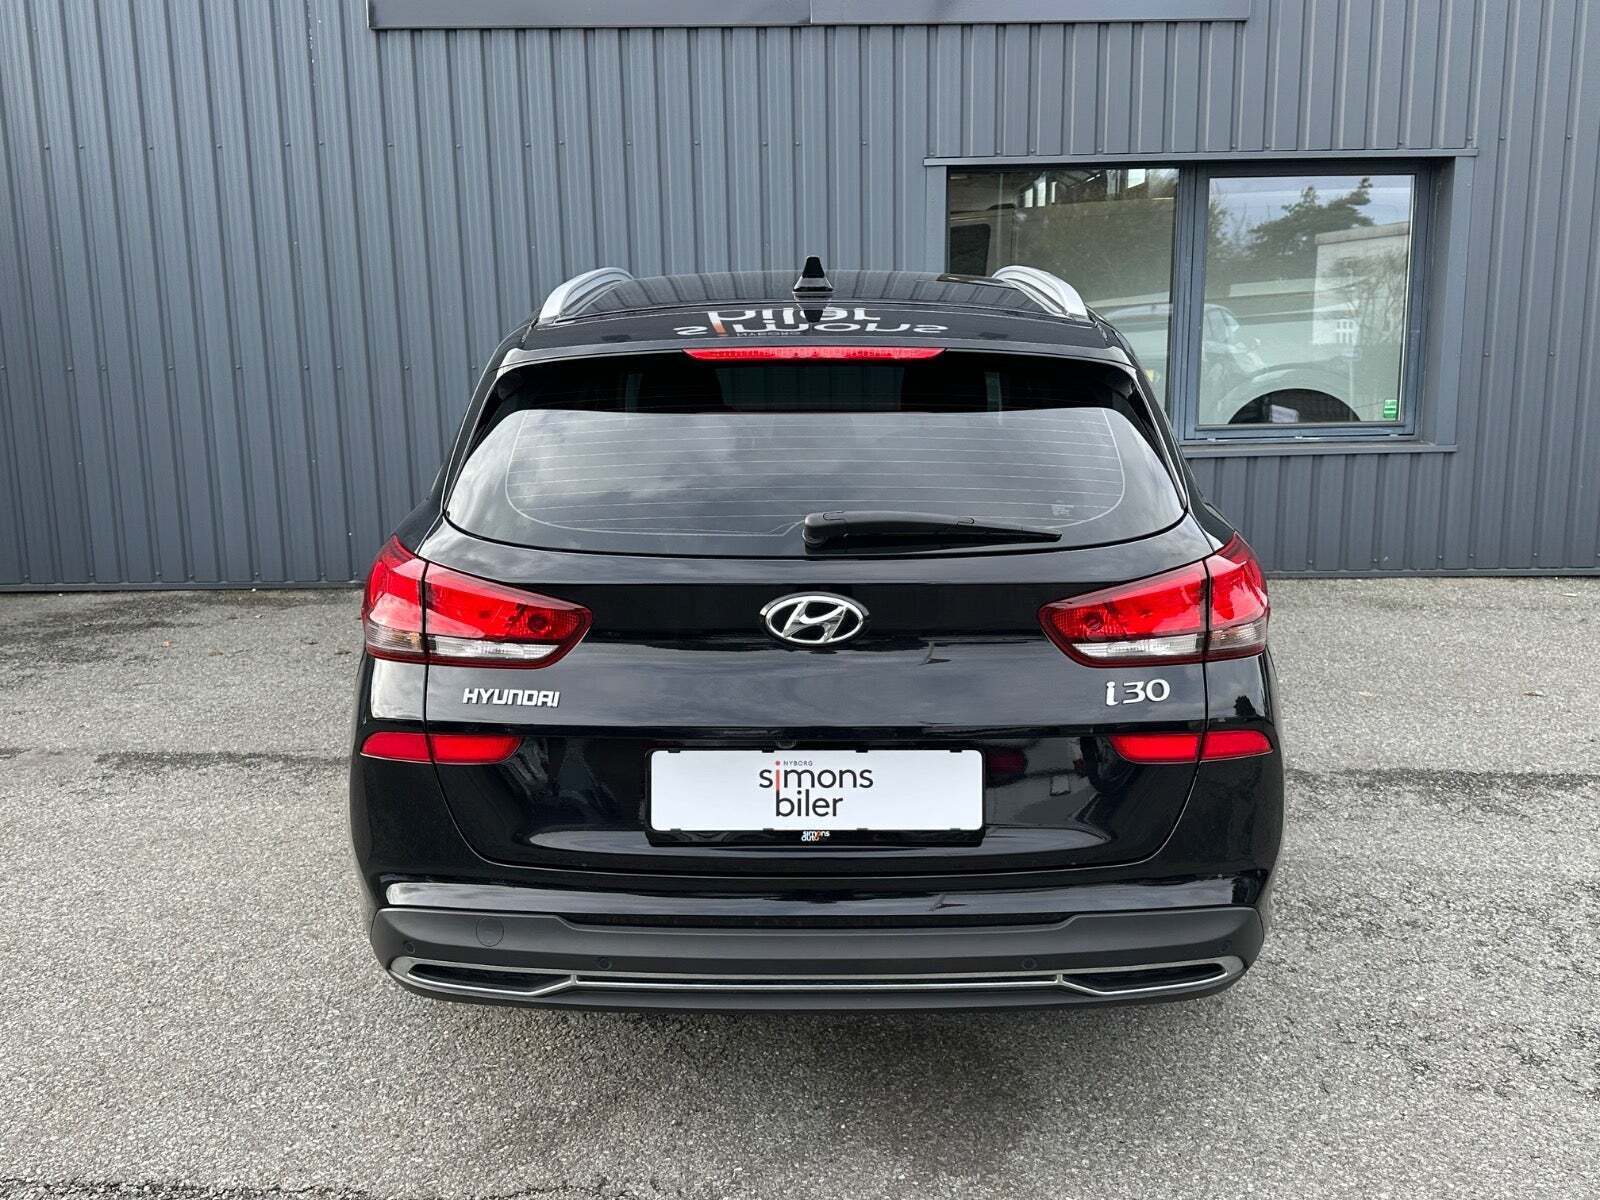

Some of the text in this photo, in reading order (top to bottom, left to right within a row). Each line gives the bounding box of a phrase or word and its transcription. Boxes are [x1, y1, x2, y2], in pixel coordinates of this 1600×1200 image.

[462, 687, 560, 708] HYUNDAI
[1105, 678, 1171, 706] i30
[759, 760, 874, 789] simons
[775, 789, 844, 817] biler
